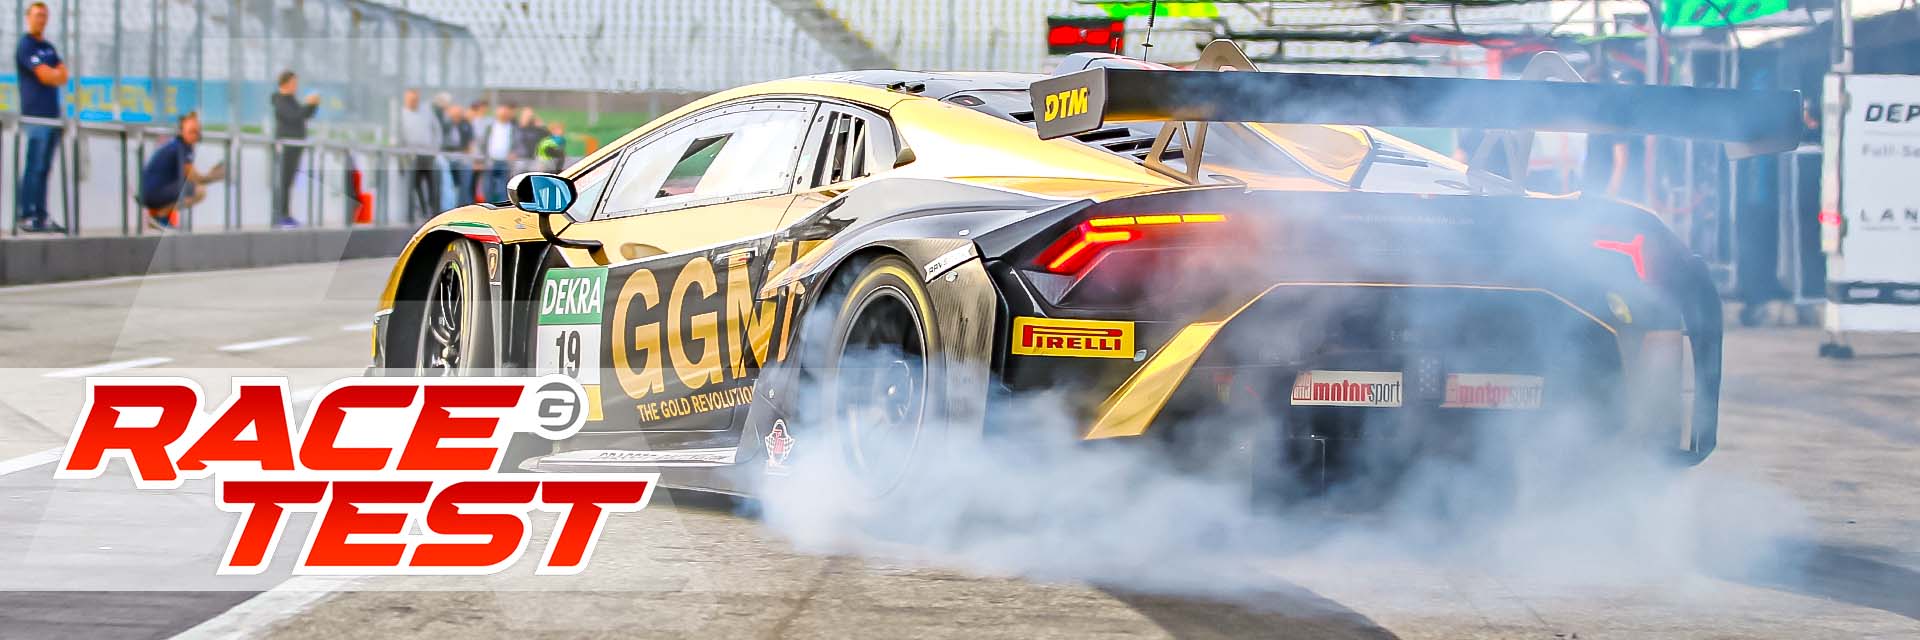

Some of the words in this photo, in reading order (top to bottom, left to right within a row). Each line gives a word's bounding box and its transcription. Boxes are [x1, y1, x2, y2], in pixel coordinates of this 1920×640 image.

[1045, 87, 1088, 122] DTM
[541, 276, 601, 315] DEKRA
[1022, 325, 1122, 350] PIRELLI
[555, 330, 581, 379] 19
[1313, 379, 1400, 405] motorsport
[637, 402, 660, 422] THE
[660, 397, 691, 418] GOLD
